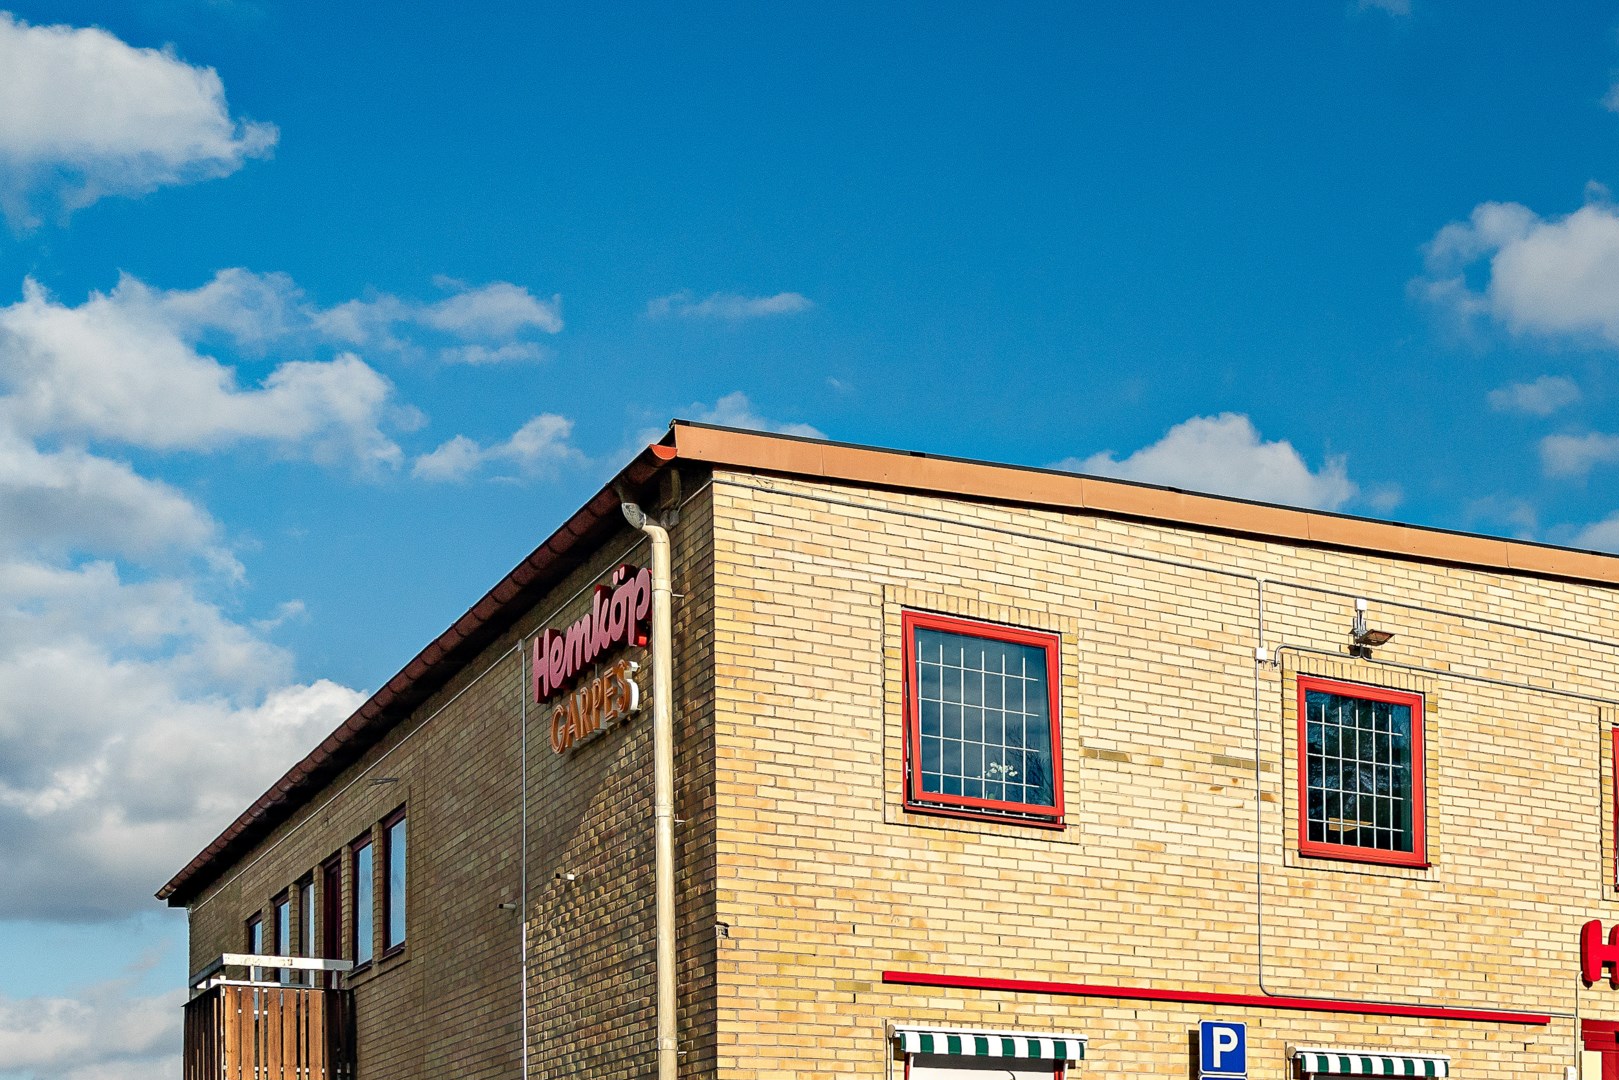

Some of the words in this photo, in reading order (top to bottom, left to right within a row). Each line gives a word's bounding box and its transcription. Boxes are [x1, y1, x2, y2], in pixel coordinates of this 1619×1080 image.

[532, 564, 652, 703] Hemköp
[551, 659, 638, 754] GARPES
[1212, 1026, 1239, 1068] P
